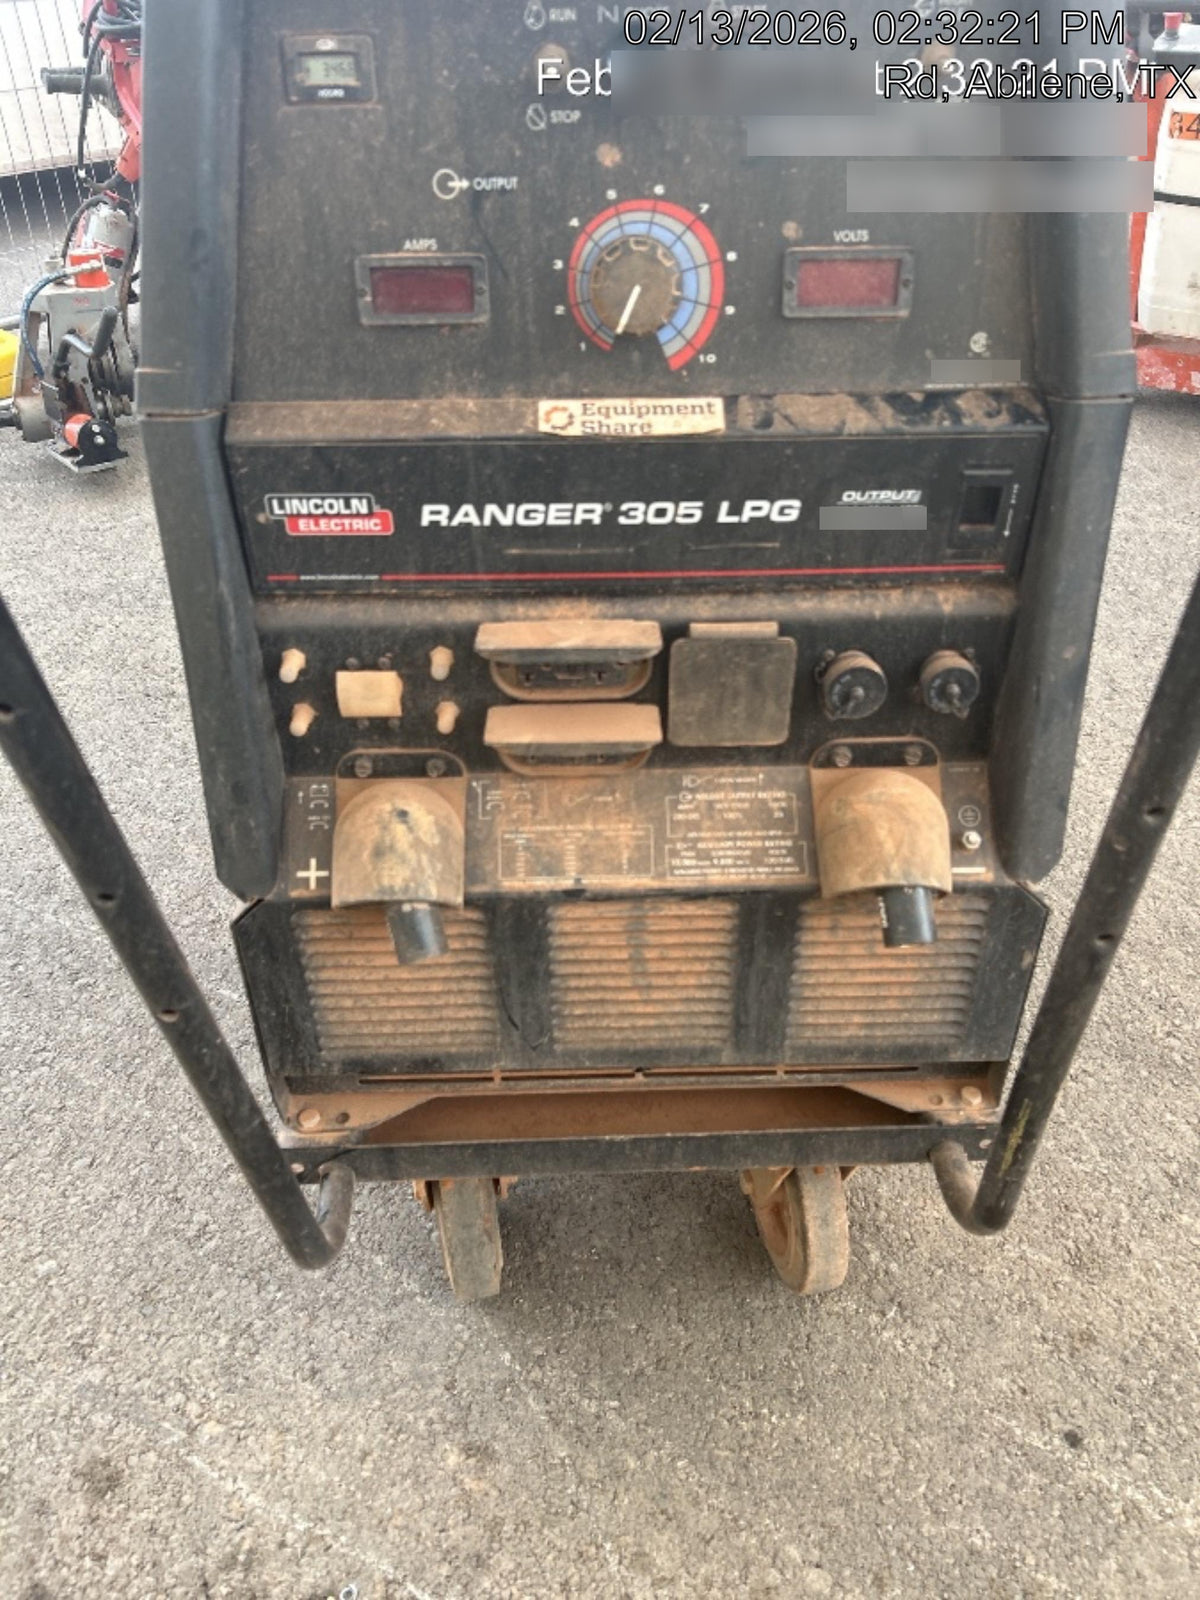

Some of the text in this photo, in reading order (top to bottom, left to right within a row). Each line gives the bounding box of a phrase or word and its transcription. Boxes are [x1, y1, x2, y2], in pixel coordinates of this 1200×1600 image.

[473, 176, 519, 191] OUTPUT
[699, 202, 711, 214] 7
[568, 217, 580, 227] 4
[833, 229, 870, 242] VOLTS
[403, 238, 438, 251] AMPS
[552, 258, 564, 270] 3
[699, 353, 717, 364] 10
[581, 401, 716, 420] Equipment
[581, 420, 652, 435] Share
[841, 489, 916, 502] OUTPUT
[271, 498, 370, 515] LINCOLN
[617, 500, 704, 526] 305
[716, 499, 802, 524] LPG
[297, 517, 383, 532] ELECTRIC
